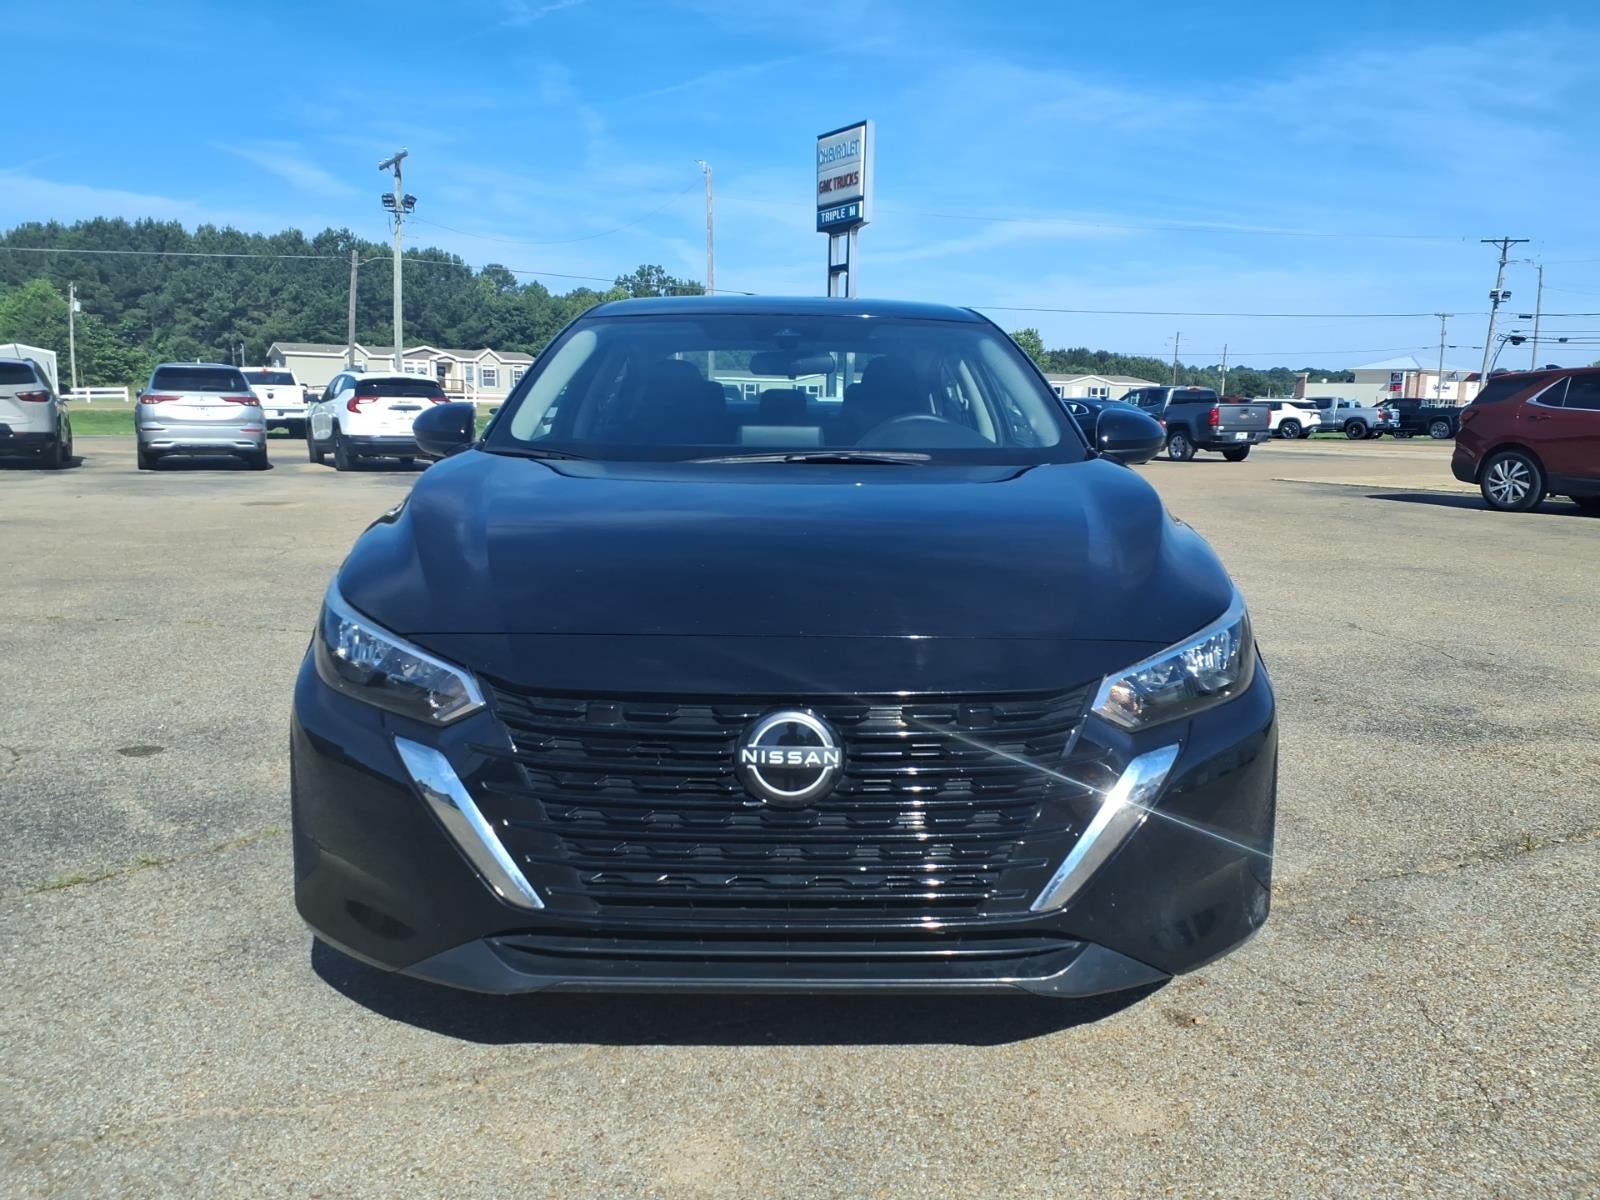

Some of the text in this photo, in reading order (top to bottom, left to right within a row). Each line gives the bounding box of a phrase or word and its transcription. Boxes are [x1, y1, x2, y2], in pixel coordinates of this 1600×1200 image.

[819, 139, 860, 165] CHEVROLET
[833, 171, 859, 190] TRUCKS
[821, 206, 856, 223] TRIPLE M
[742, 749, 839, 764] NISSAN
